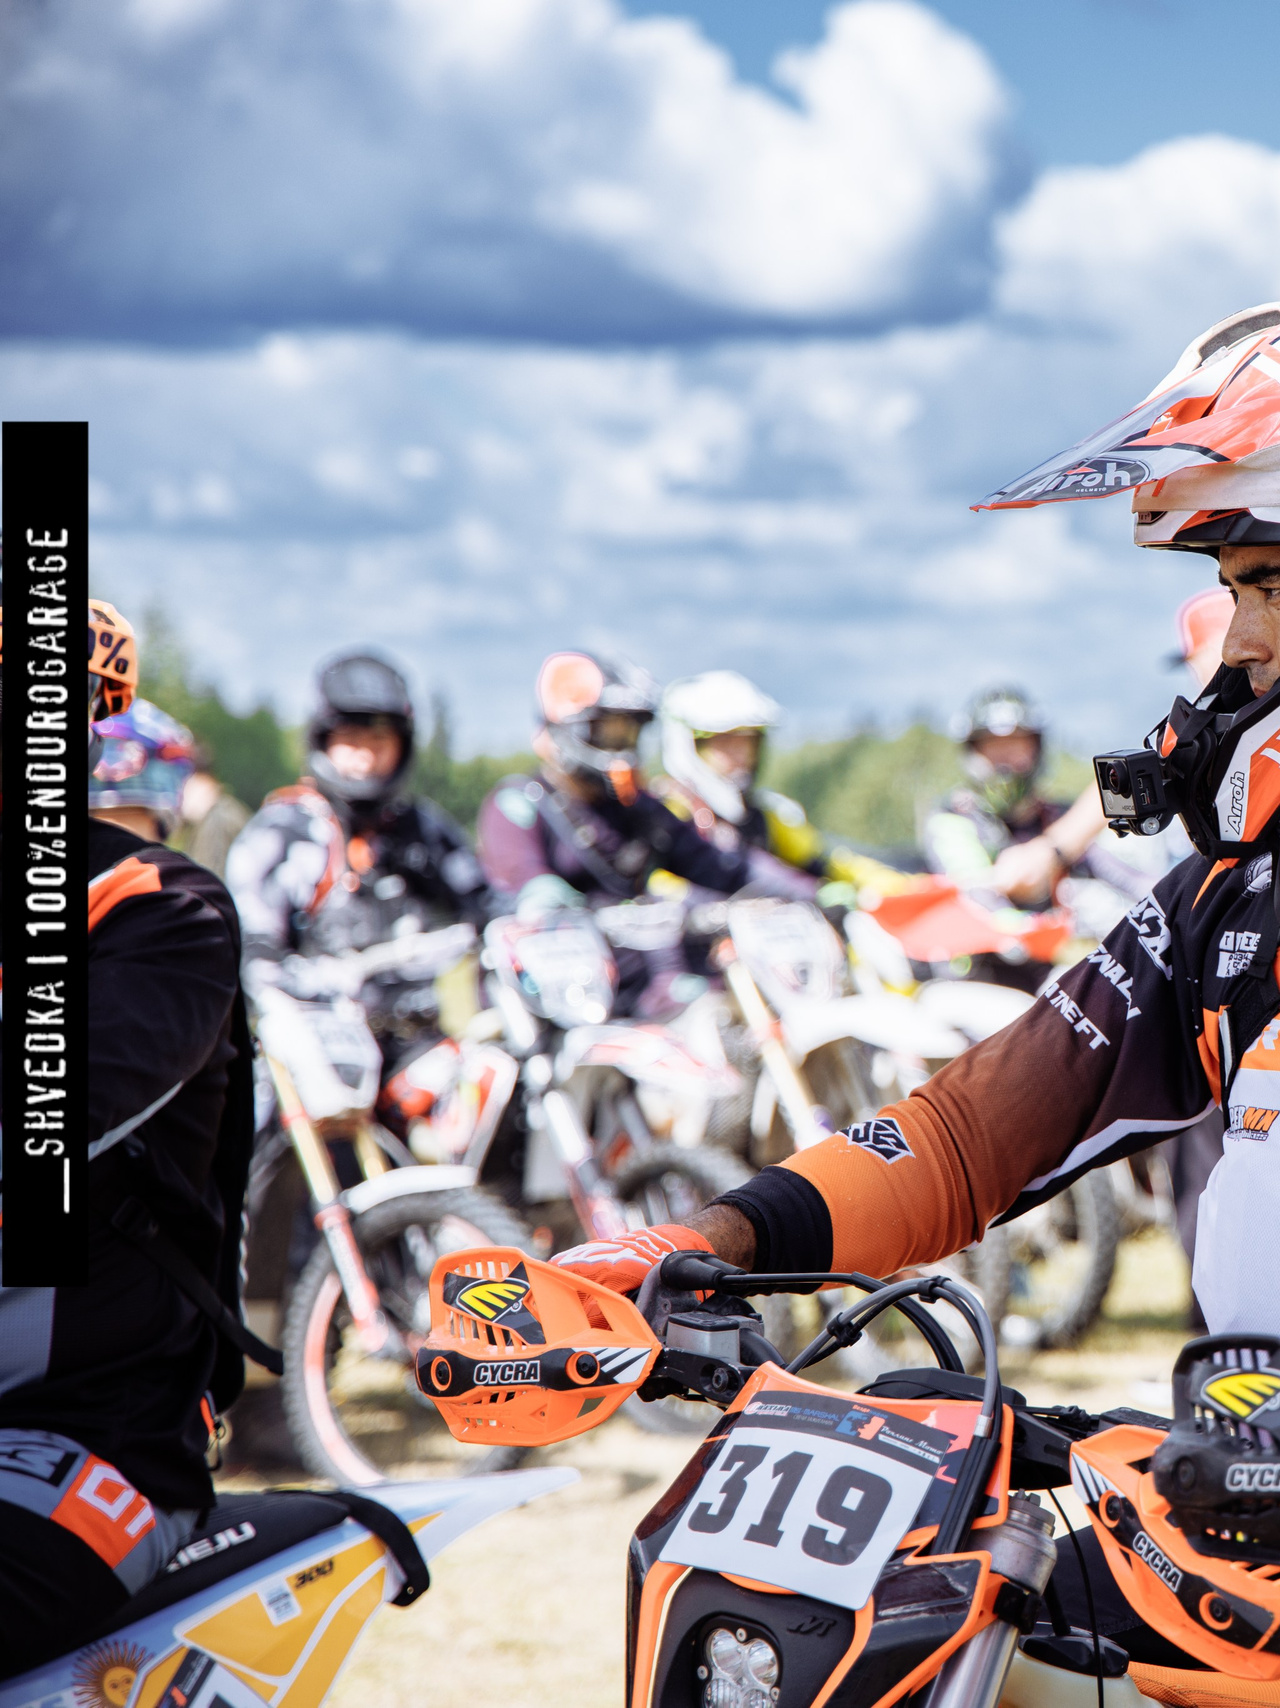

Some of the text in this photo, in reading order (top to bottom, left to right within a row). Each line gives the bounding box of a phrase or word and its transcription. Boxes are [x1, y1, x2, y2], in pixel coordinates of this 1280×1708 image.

[474, 1360, 541, 1385] CYCRA
[688, 1444, 893, 1567] 319
[1133, 1531, 1184, 1593] CYCRA
